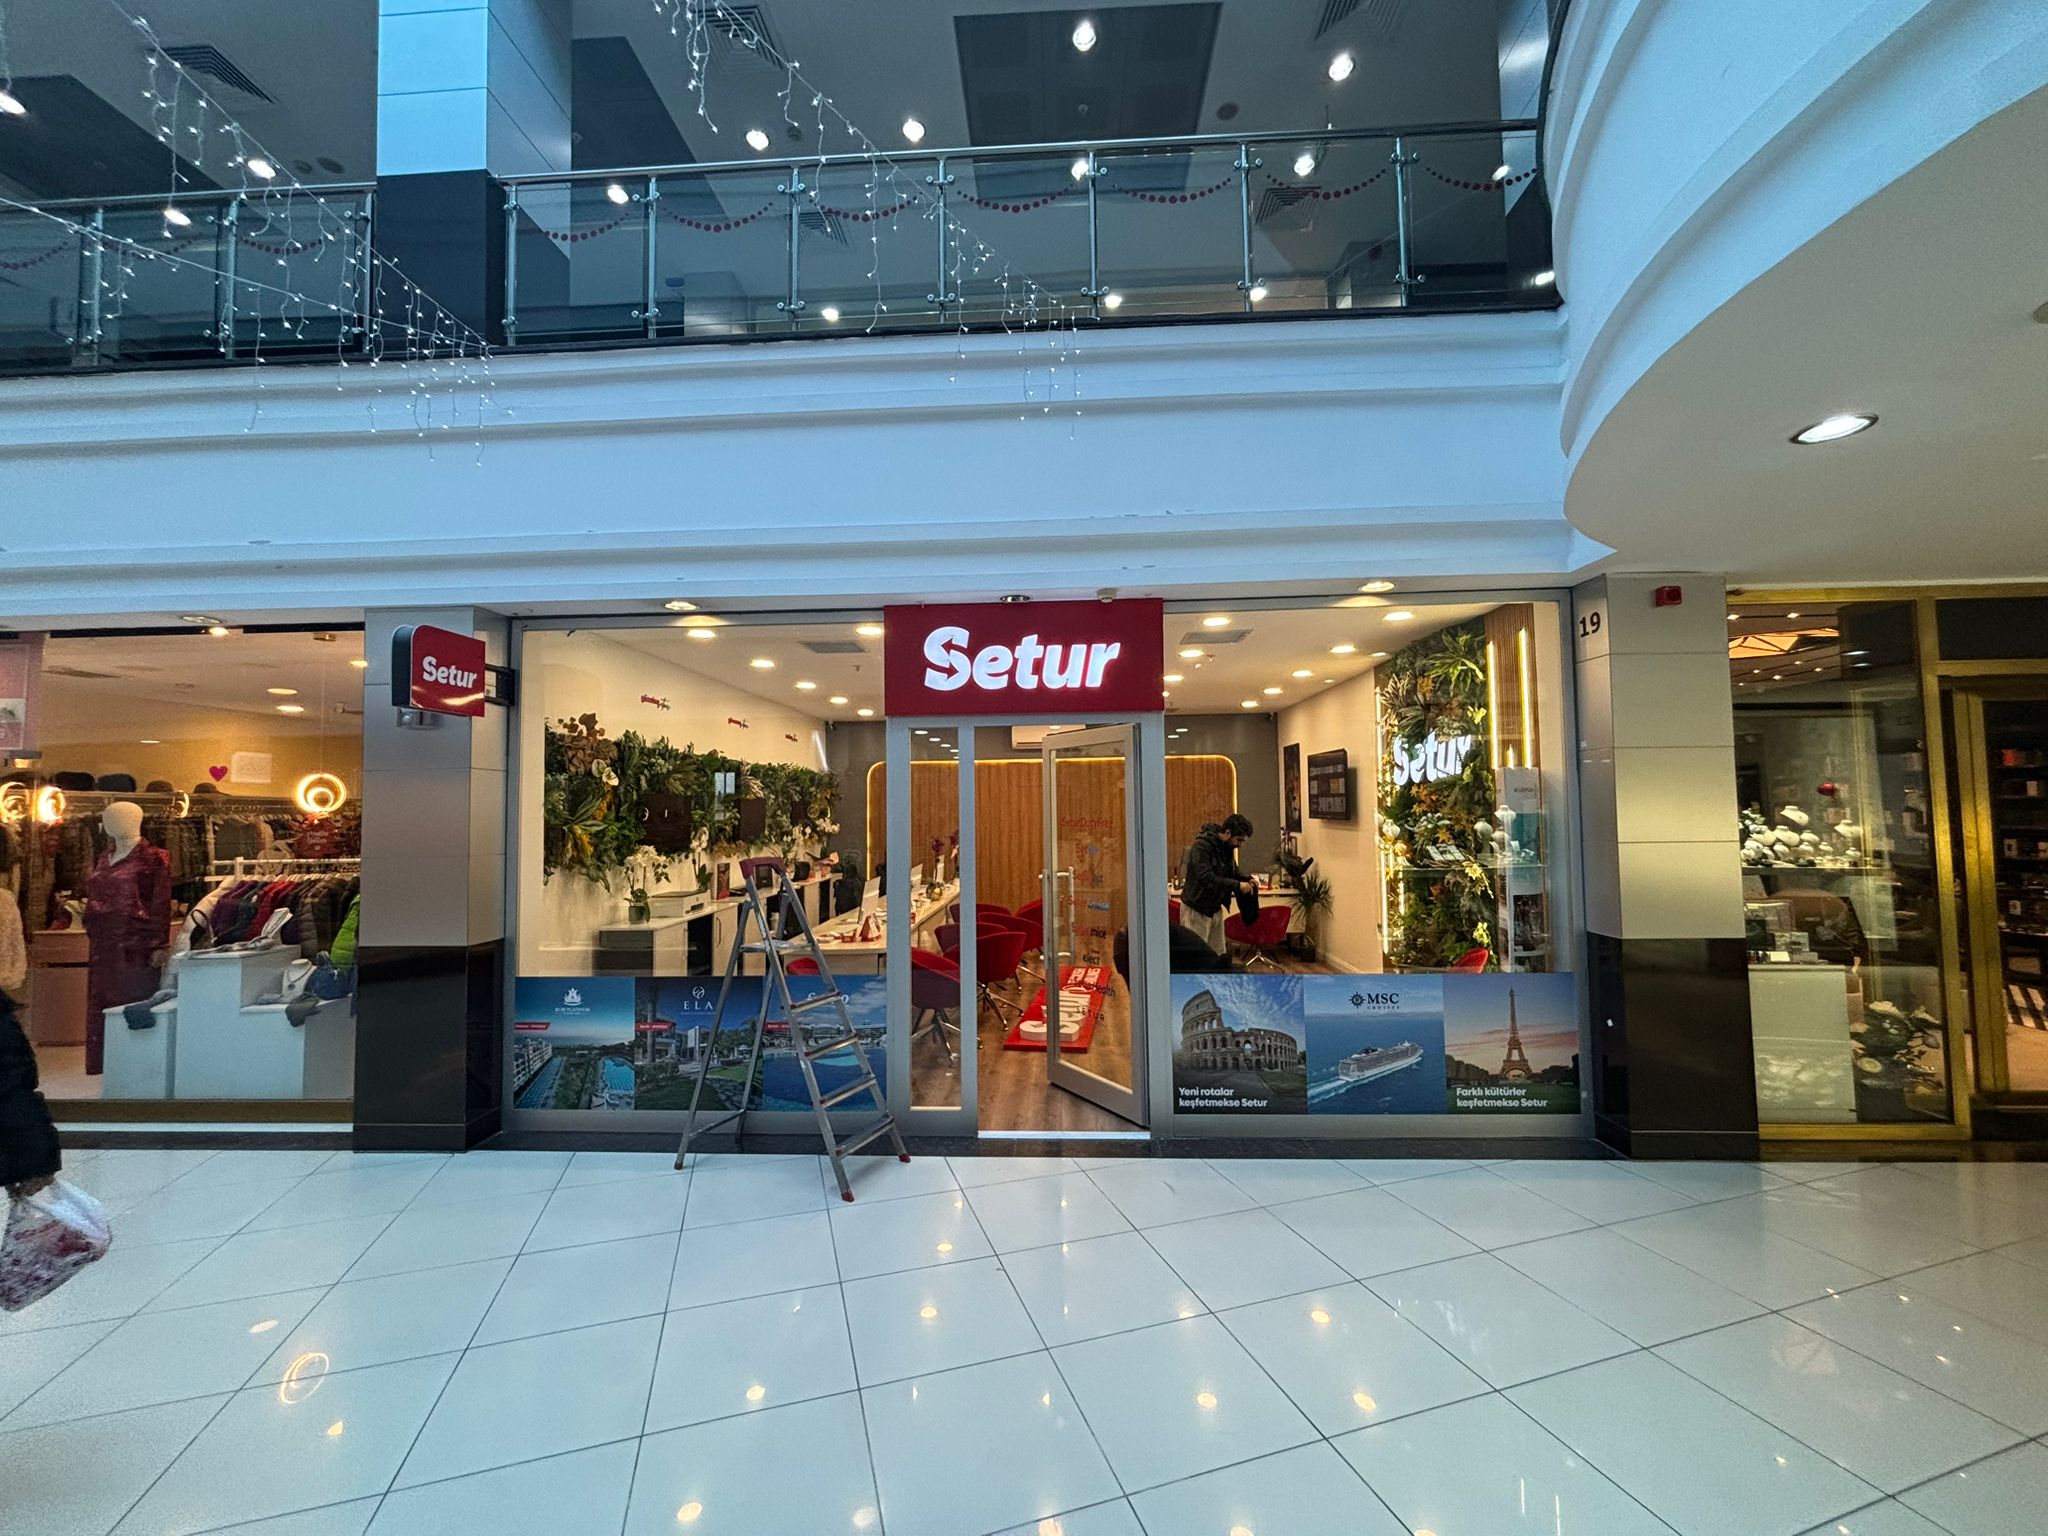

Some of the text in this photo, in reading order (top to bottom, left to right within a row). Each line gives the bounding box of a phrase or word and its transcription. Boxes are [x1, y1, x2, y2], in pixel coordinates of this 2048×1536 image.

[1580, 611, 1600, 638] 19
[923, 625, 1121, 691] Setur
[422, 655, 478, 688] Setur
[1393, 732, 1472, 786] Setur
[1367, 992, 1399, 1004] MSC
[683, 1000, 714, 1010] ELA
[1179, 1086, 1234, 1096] Yeni rotalar
[1456, 1086, 1527, 1096] Farklı kültürler
[1179, 1098, 1268, 1109] keşfetmekse Setur
[1456, 1098, 1548, 1109] keşfetmekse Setur
